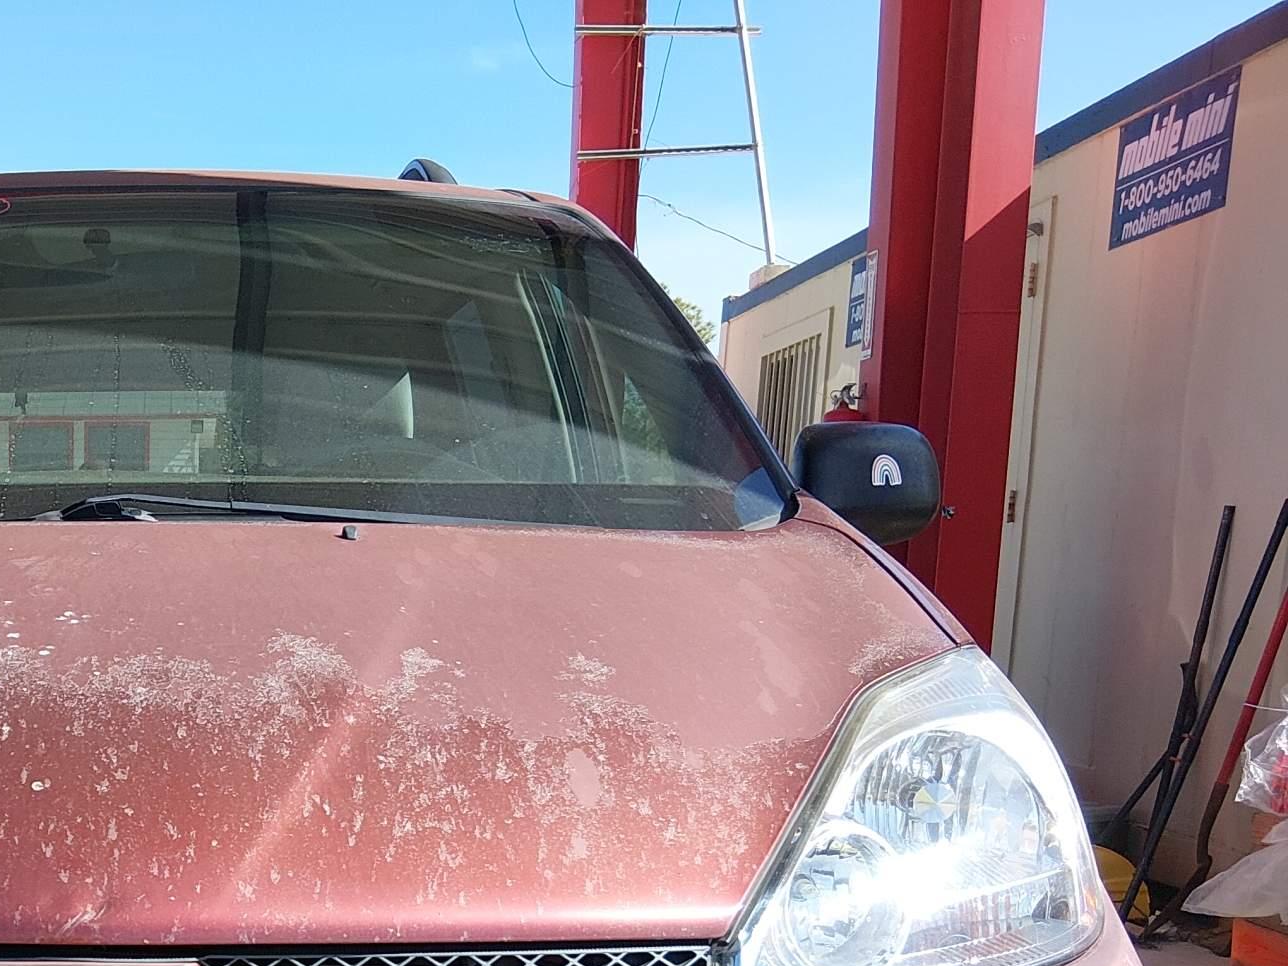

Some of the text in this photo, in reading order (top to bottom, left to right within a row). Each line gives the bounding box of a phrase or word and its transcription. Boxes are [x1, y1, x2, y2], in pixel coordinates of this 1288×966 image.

[1118, 82, 1239, 180] mobile mini
[1119, 147, 1223, 215] 1-800-950-6464
[1120, 189, 1212, 241] mobilemini.com
